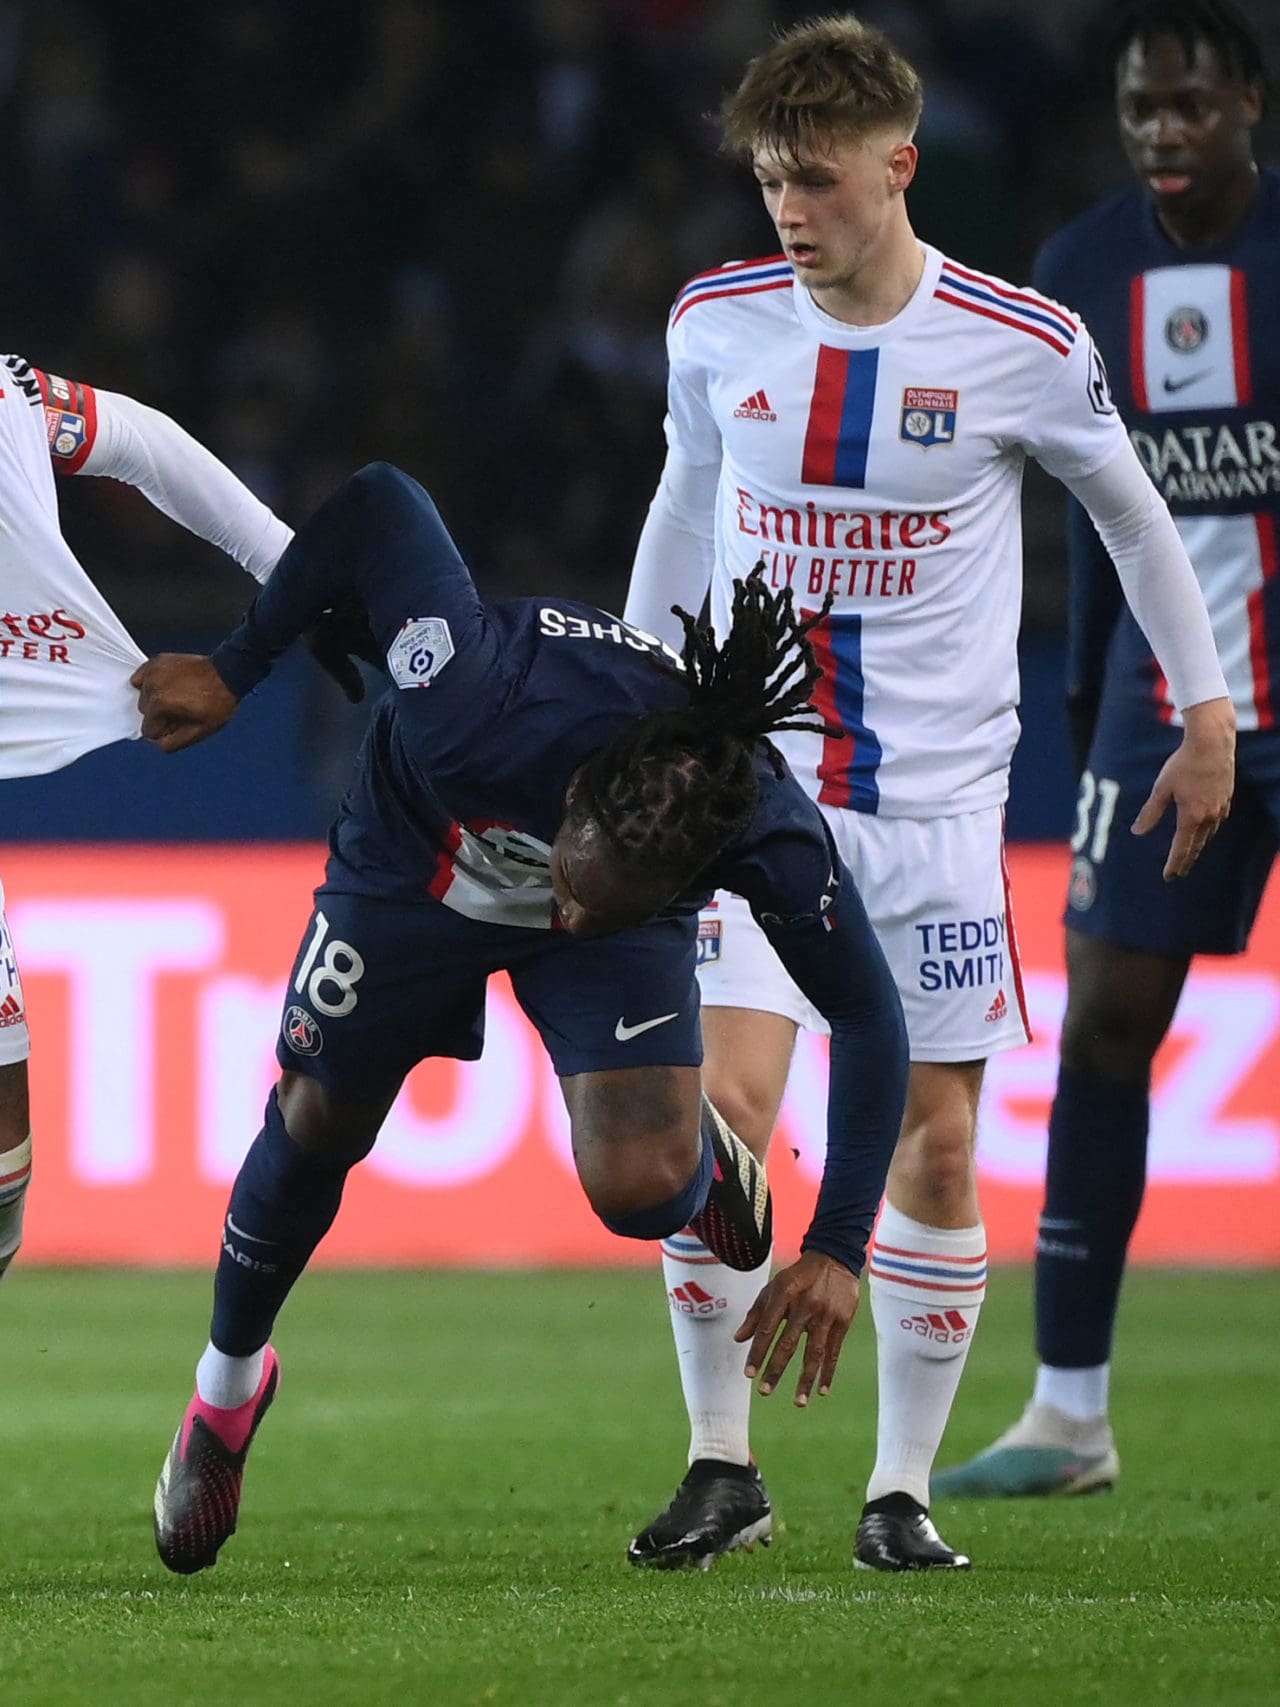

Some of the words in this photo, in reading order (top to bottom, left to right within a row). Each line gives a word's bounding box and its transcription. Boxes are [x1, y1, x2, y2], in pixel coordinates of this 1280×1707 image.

[1129, 421, 1280, 481] QATAR
[737, 488, 952, 550] Emirates
[808, 558, 917, 596] BETTER
[915, 912, 1004, 954] TEDDY
[294, 910, 365, 1018] 18
